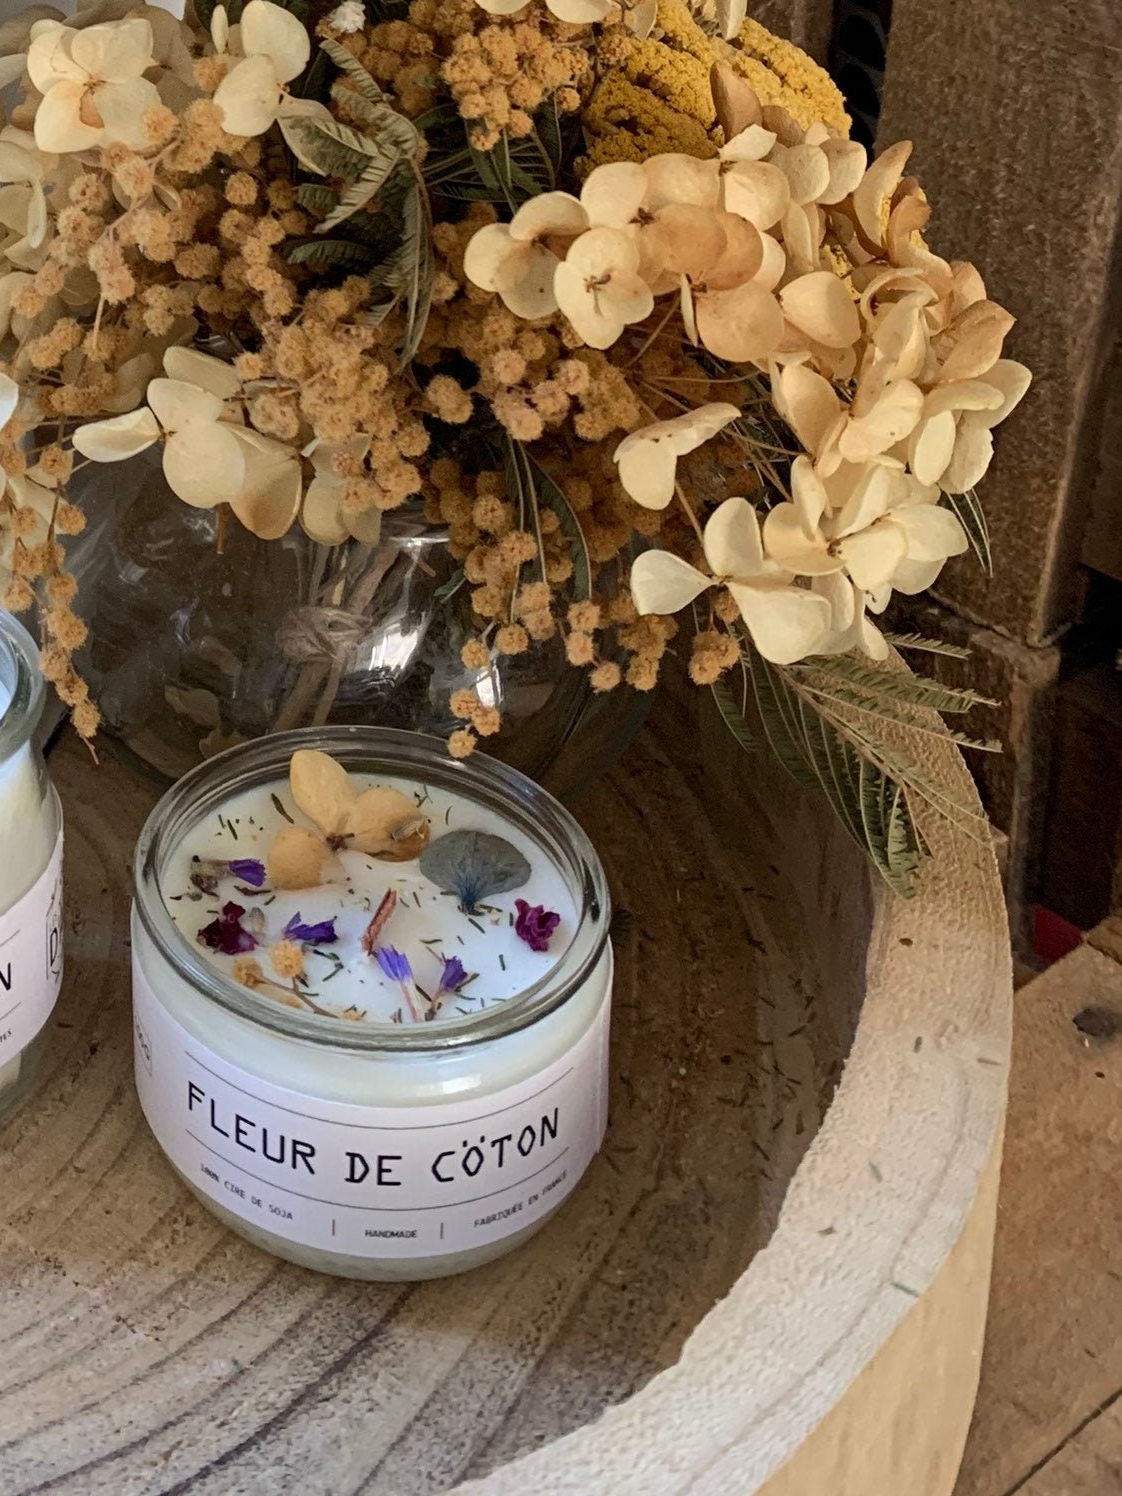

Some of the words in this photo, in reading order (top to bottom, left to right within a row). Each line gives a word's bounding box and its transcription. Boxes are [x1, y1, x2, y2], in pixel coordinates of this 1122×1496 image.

[187, 1080, 317, 1176] FLEUR
[344, 1151, 403, 1186] DE
[431, 1107, 560, 1183] CÖTON
[224, 1180, 246, 1199] CIRE
[251, 1195, 263, 1208] DE
[268, 1204, 294, 1220] SOJA
[365, 1229, 418, 1239] HANDMADE
